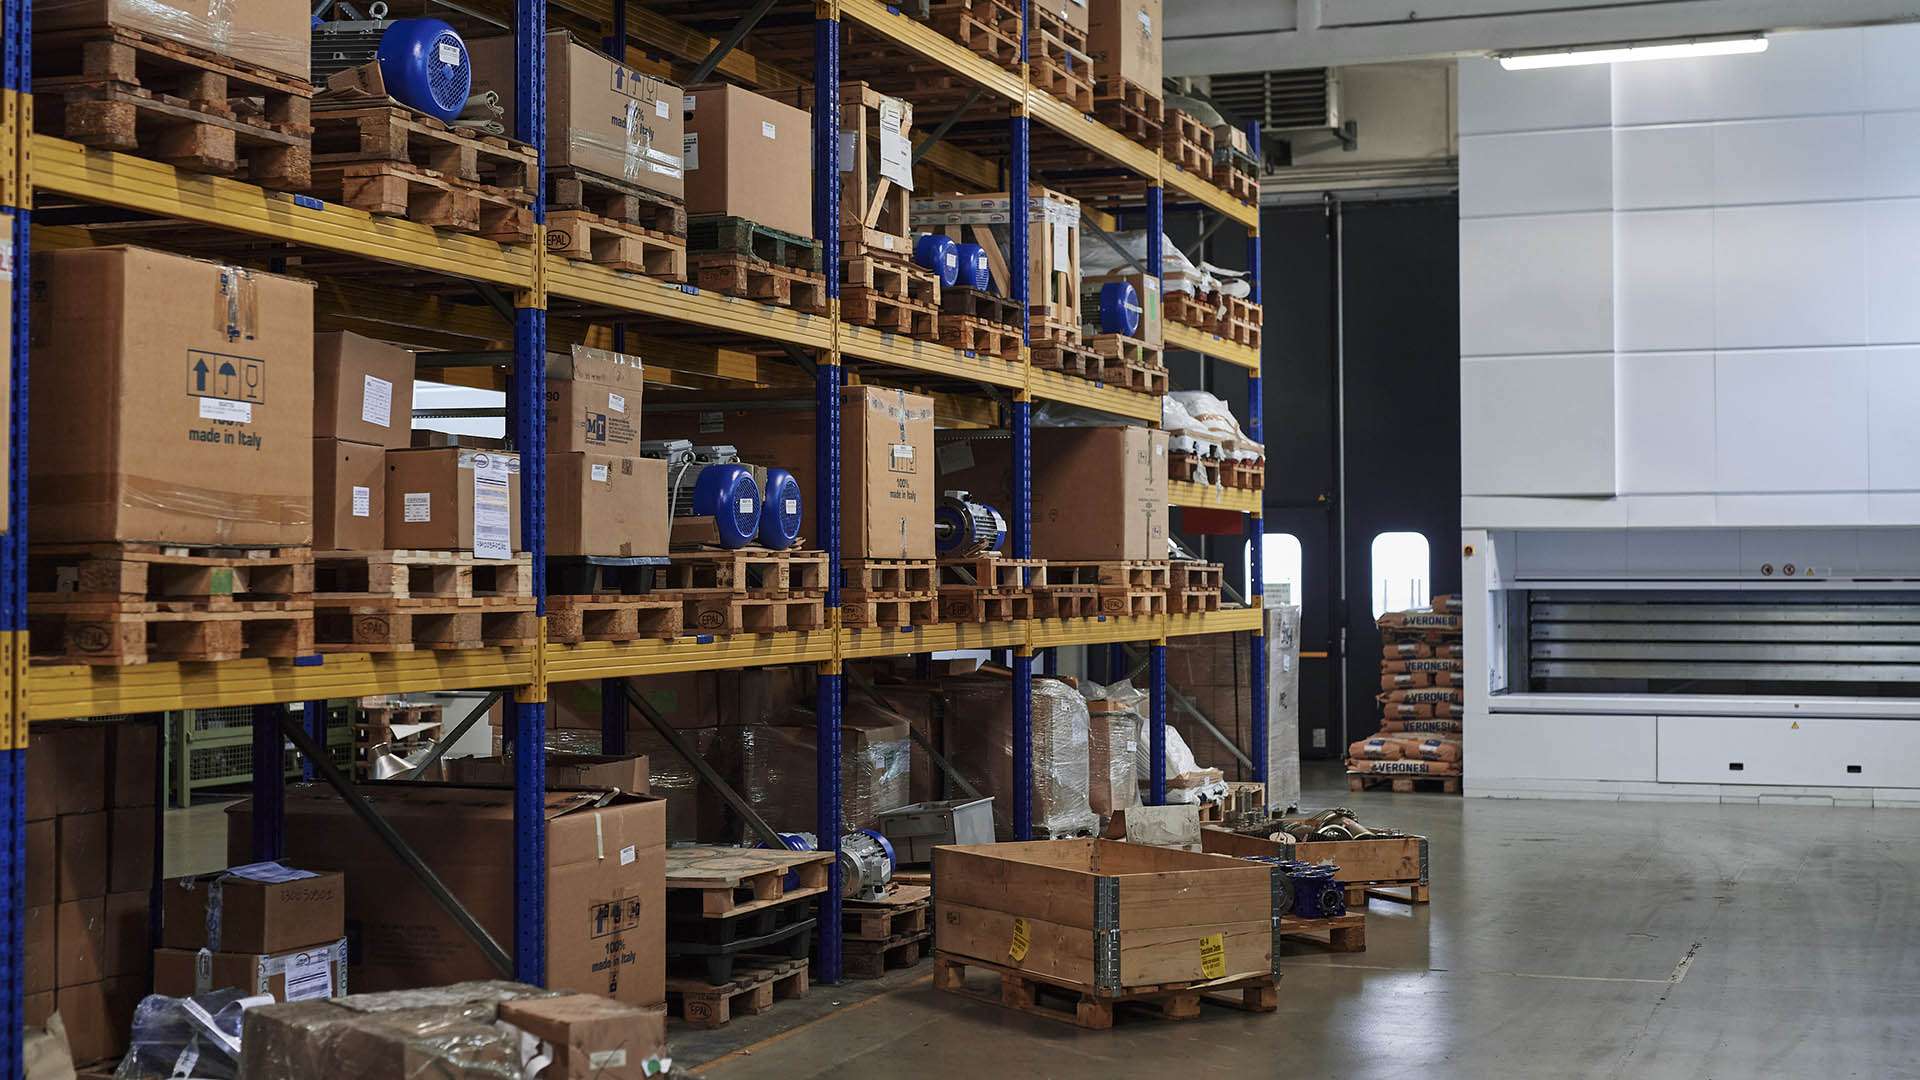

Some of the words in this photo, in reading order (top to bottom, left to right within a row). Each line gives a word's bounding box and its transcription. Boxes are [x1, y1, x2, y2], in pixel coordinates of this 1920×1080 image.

[546, 234, 566, 246] EPAL
[189, 428, 220, 443] made
[224, 429, 234, 444] in
[238, 430, 261, 451] Italy
[896, 478, 909, 488] 100%
[890, 490, 901, 499] made
[907, 490, 916, 503] Italy
[702, 614, 720, 625] EPAL
[1410, 615, 1457, 626] VERONESI
[1404, 661, 1452, 672] VERONESI
[1412, 692, 1458, 703] VERONESI
[1403, 720, 1451, 732] VERONESI
[1380, 762, 1429, 773] VERONESI
[605, 940, 625, 954] 100%
[592, 957, 611, 972] made
[621, 951, 636, 964] Italy
